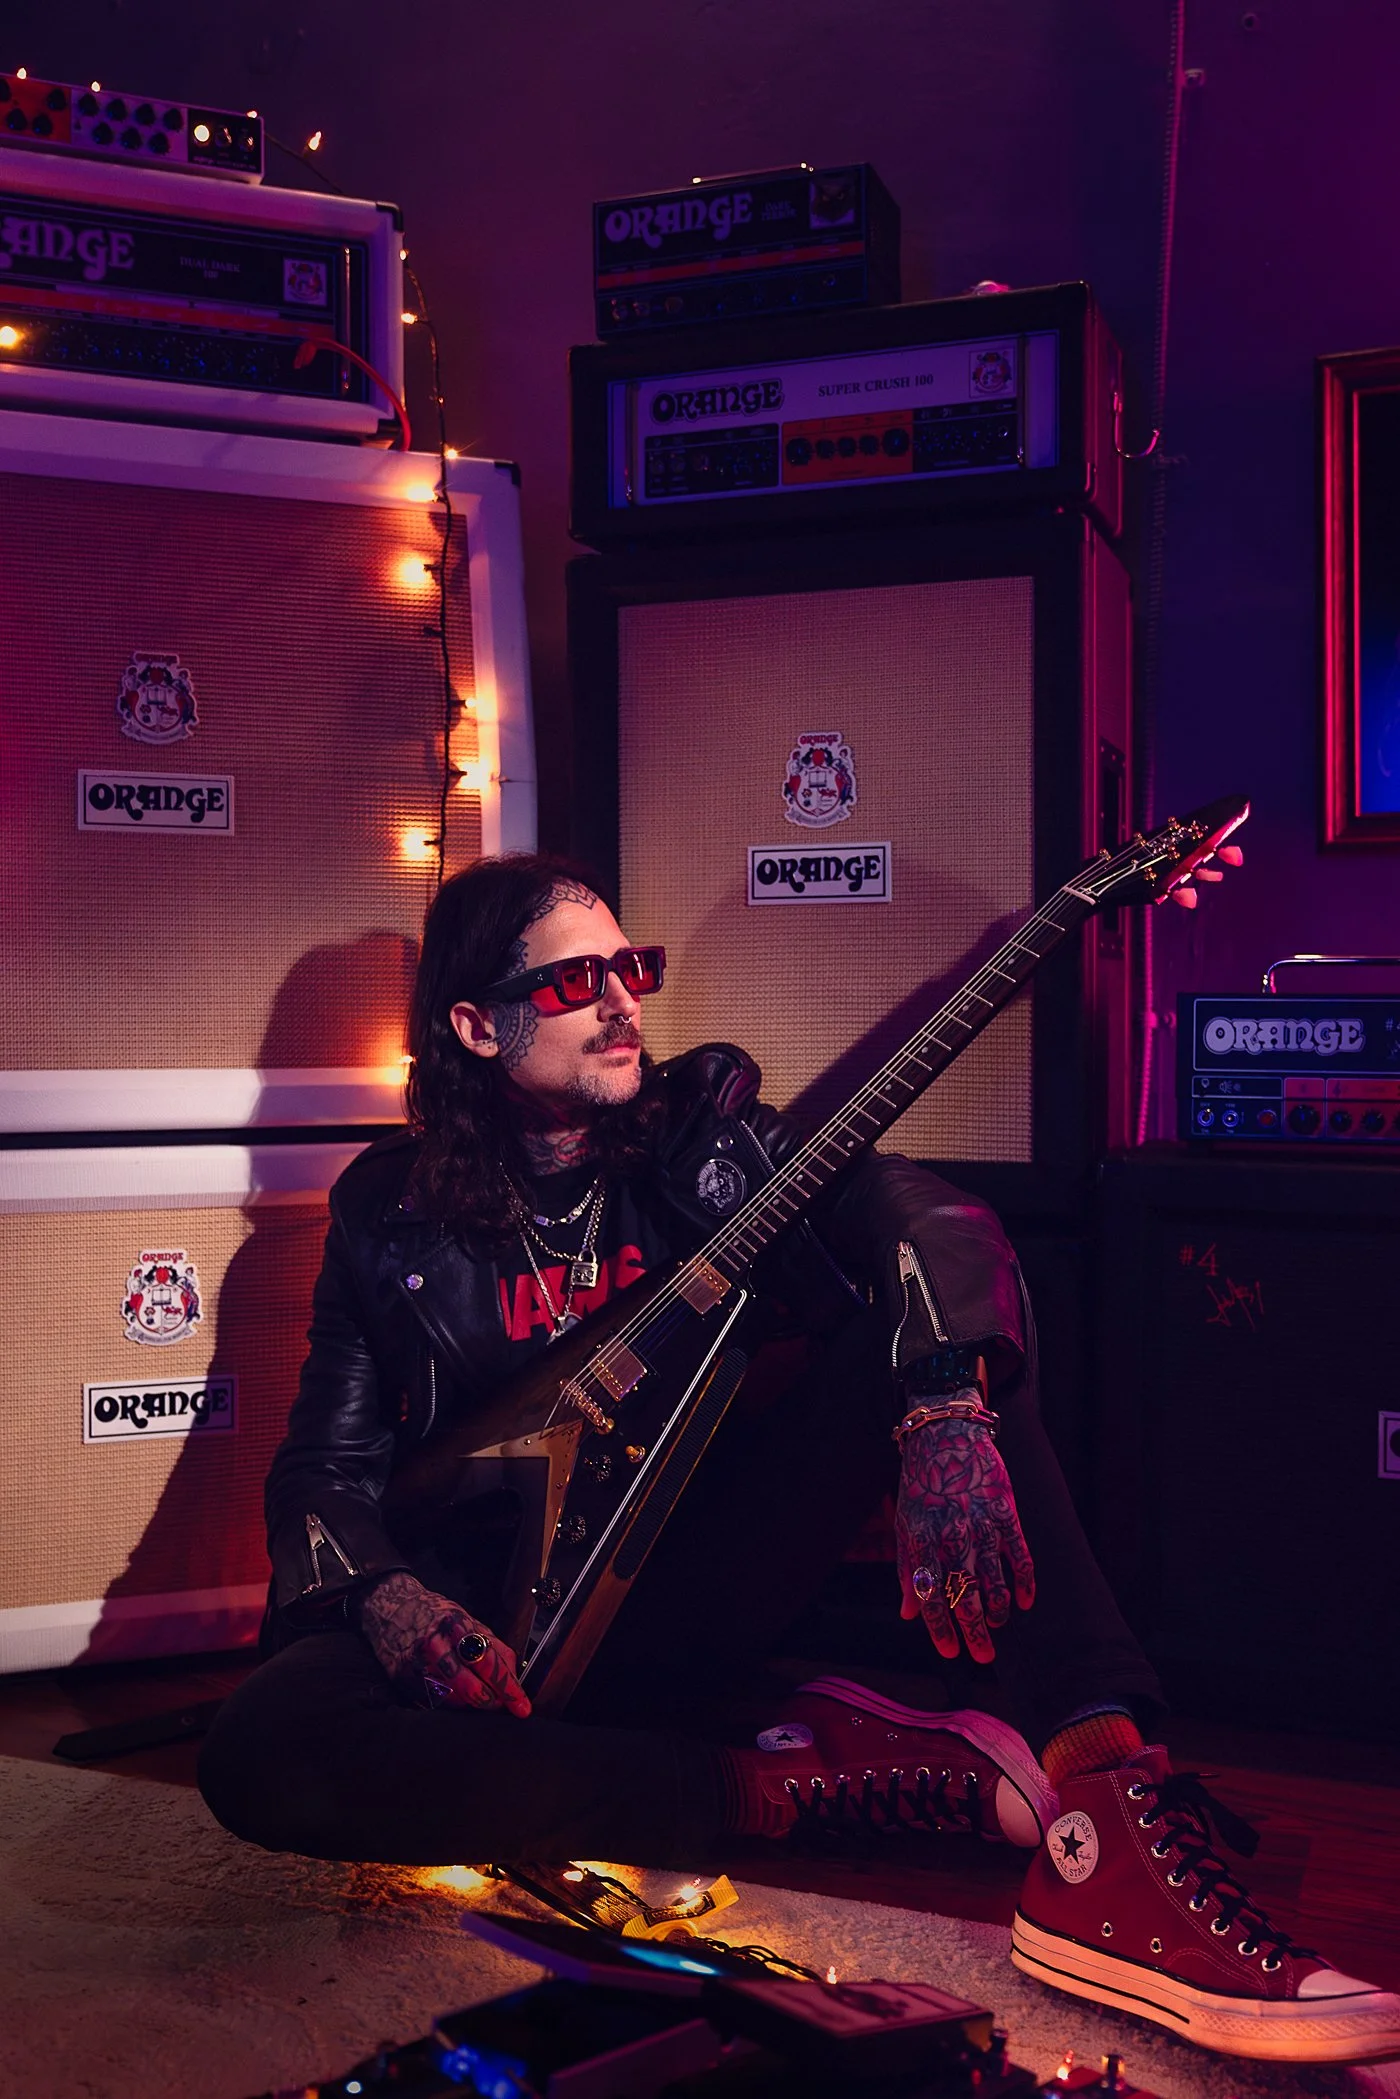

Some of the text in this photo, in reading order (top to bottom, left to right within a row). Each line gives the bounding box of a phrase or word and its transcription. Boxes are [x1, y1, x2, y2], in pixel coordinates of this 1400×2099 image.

[604, 192, 753, 249] ORANGE
[0, 216, 136, 281] ANGE
[652, 373, 934, 423] ORANGE SUPER CRUSH 100
[799, 733, 839, 746] ORANGE
[89, 783, 224, 822] ORANGE
[757, 855, 881, 893] ORANGE
[1204, 1017, 1365, 1055] ORANGE
[142, 1252, 184, 1264] ORANGE
[1179, 1242, 1220, 1277] #4
[94, 1387, 229, 1429] ORANGE
[1054, 1816, 1092, 1841] CONVERSE
[1056, 1857, 1087, 1877] ALL STAR
